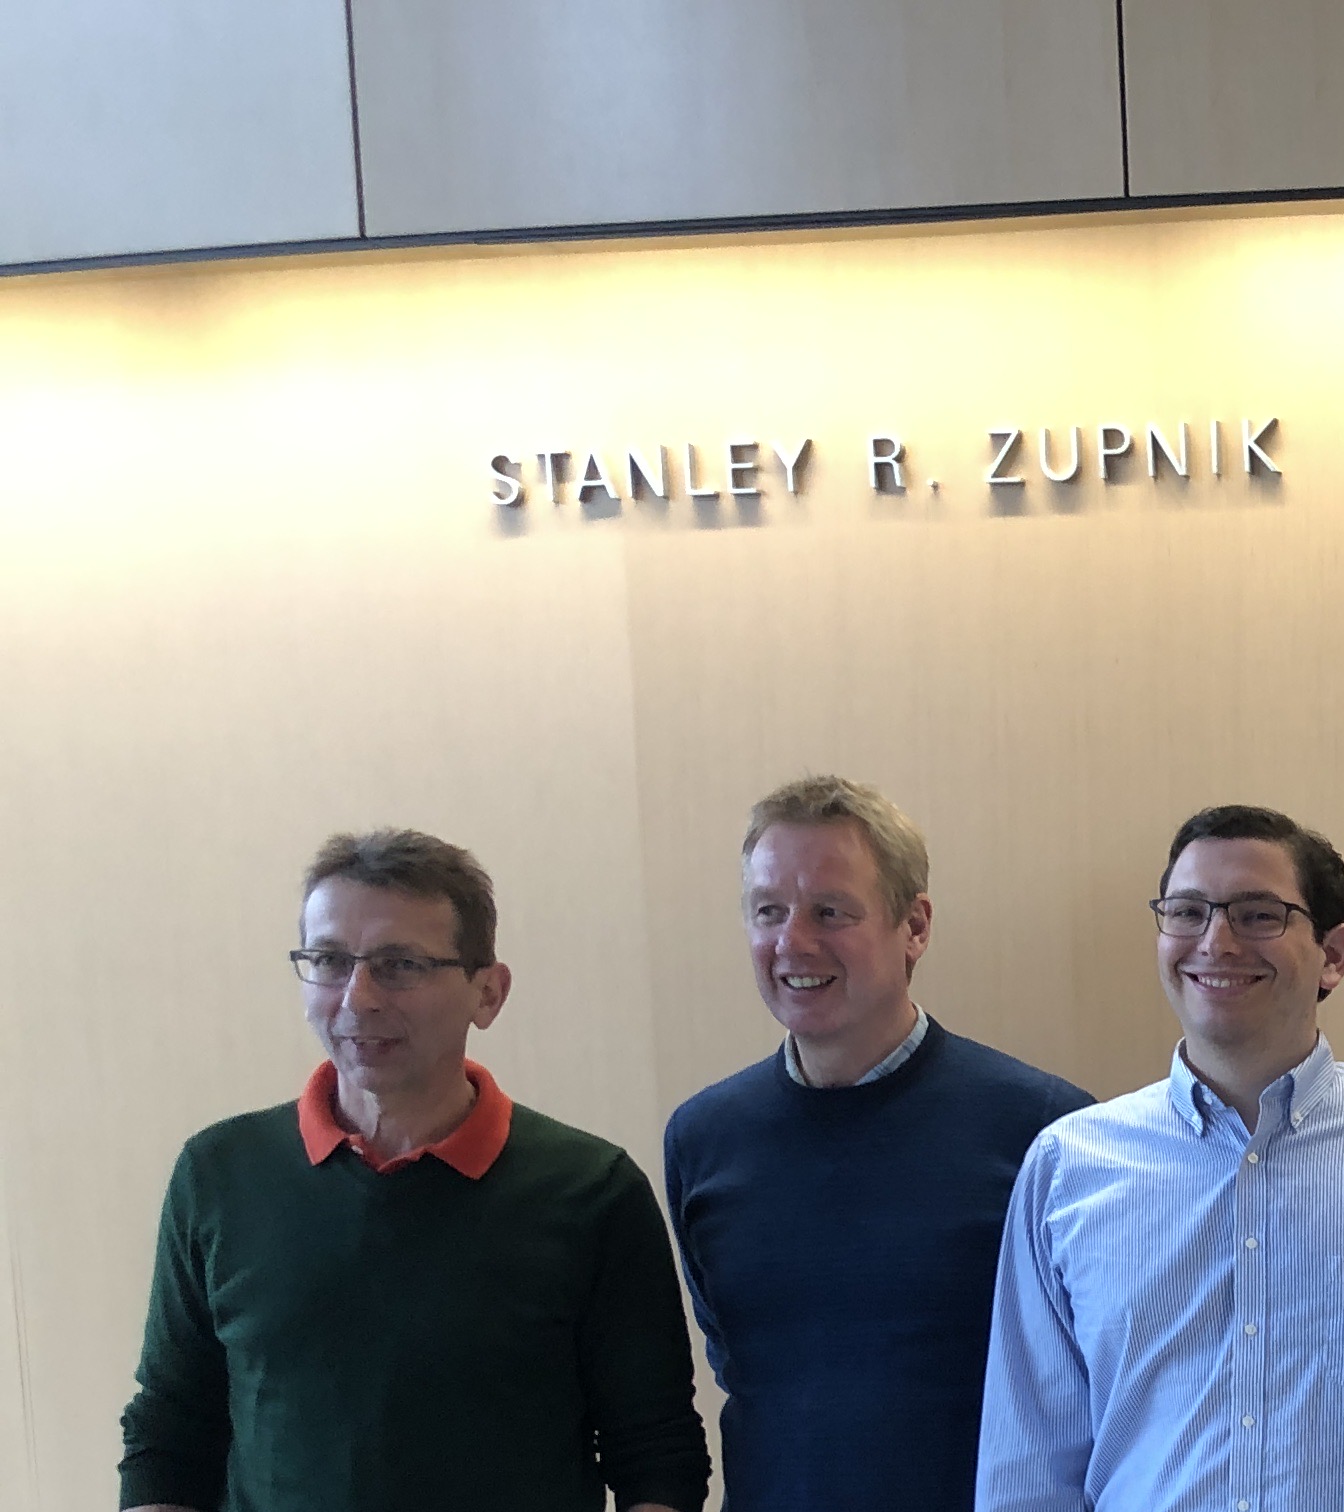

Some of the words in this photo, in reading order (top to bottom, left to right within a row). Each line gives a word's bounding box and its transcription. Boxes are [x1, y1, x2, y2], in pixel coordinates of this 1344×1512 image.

[490, 436, 812, 507] STANLEY
[867, 434, 940, 492] R.
[984, 417, 1283, 485] ZUPNIK
